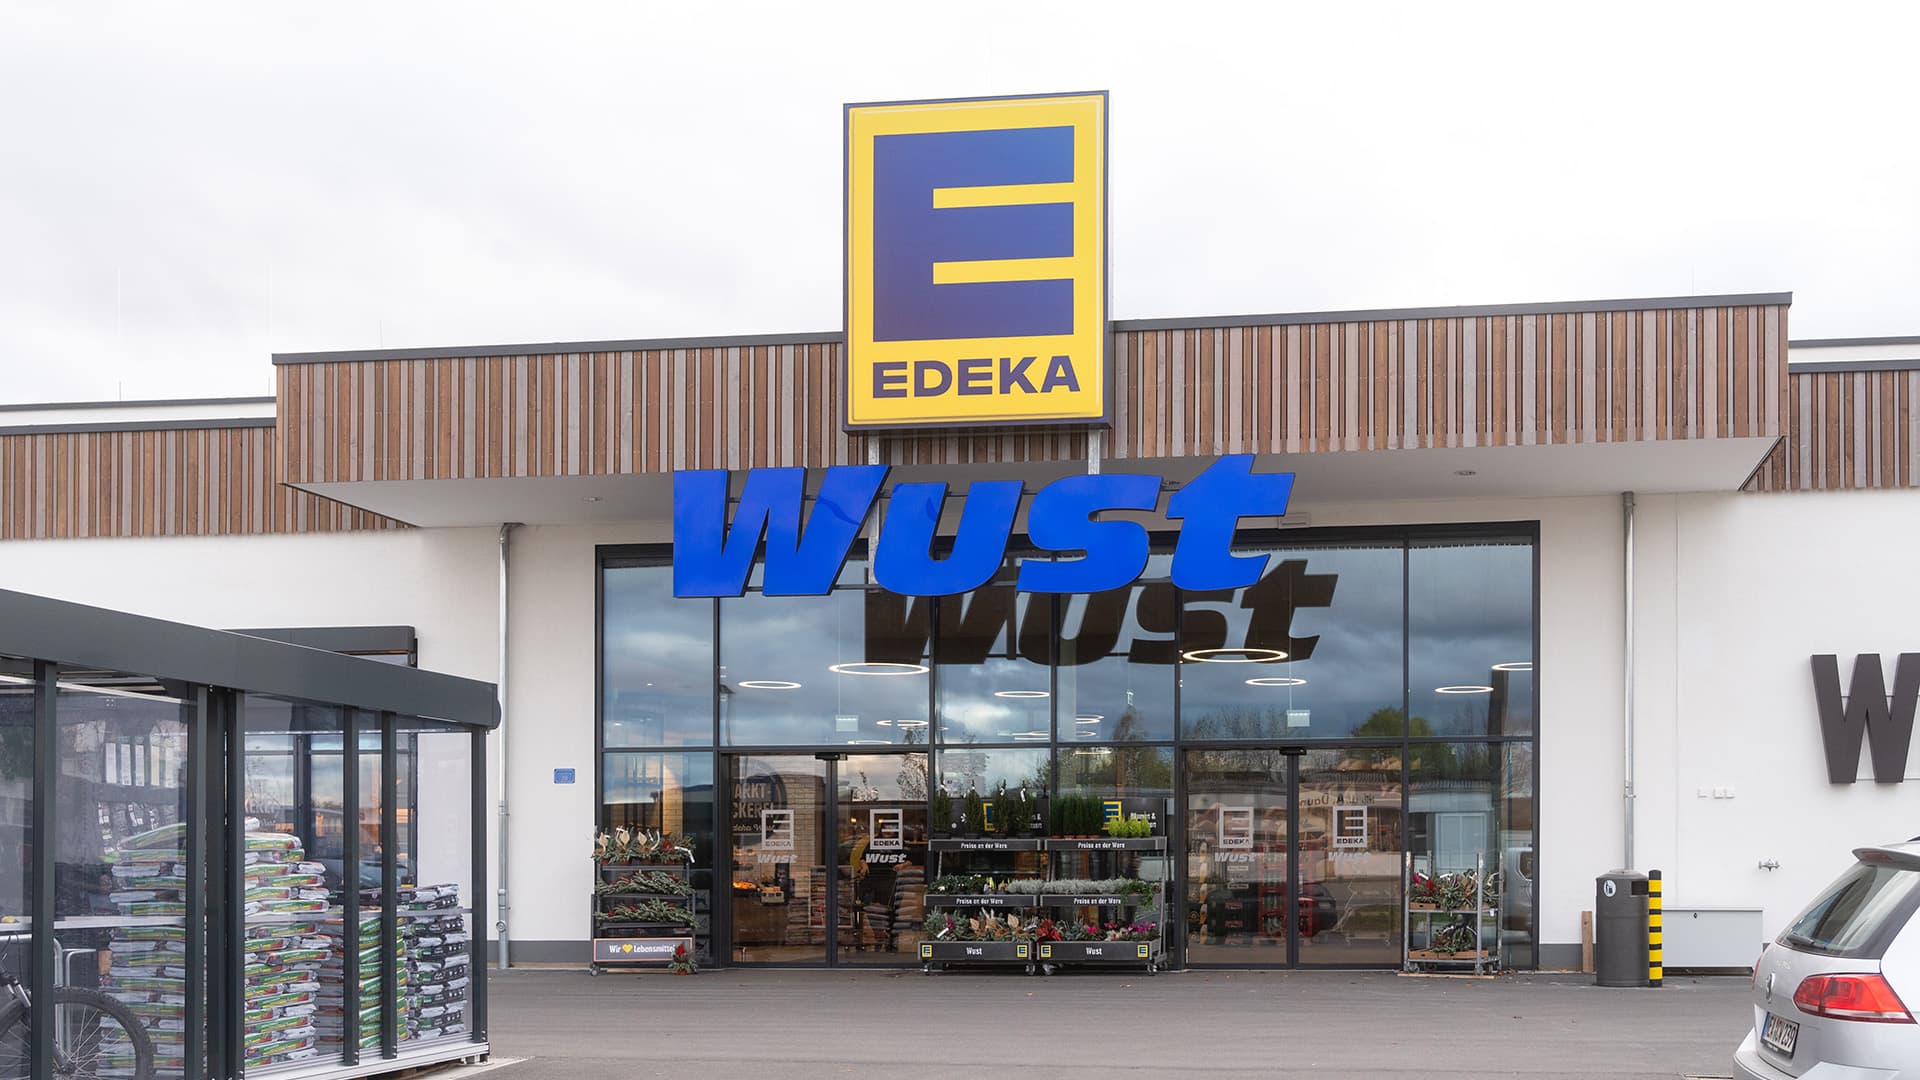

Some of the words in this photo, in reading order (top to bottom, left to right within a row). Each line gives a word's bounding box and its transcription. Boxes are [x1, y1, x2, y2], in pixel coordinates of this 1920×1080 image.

[873, 356, 1081, 399] EDEKA
[673, 454, 1295, 598] Wust
[757, 854, 798, 864] Wust
[865, 853, 907, 864] Wust
[1215, 852, 1257, 862] Wust
[609, 944, 621, 953] Wir
[966, 947, 983, 956] Wust
[1085, 947, 1102, 956] Wust
